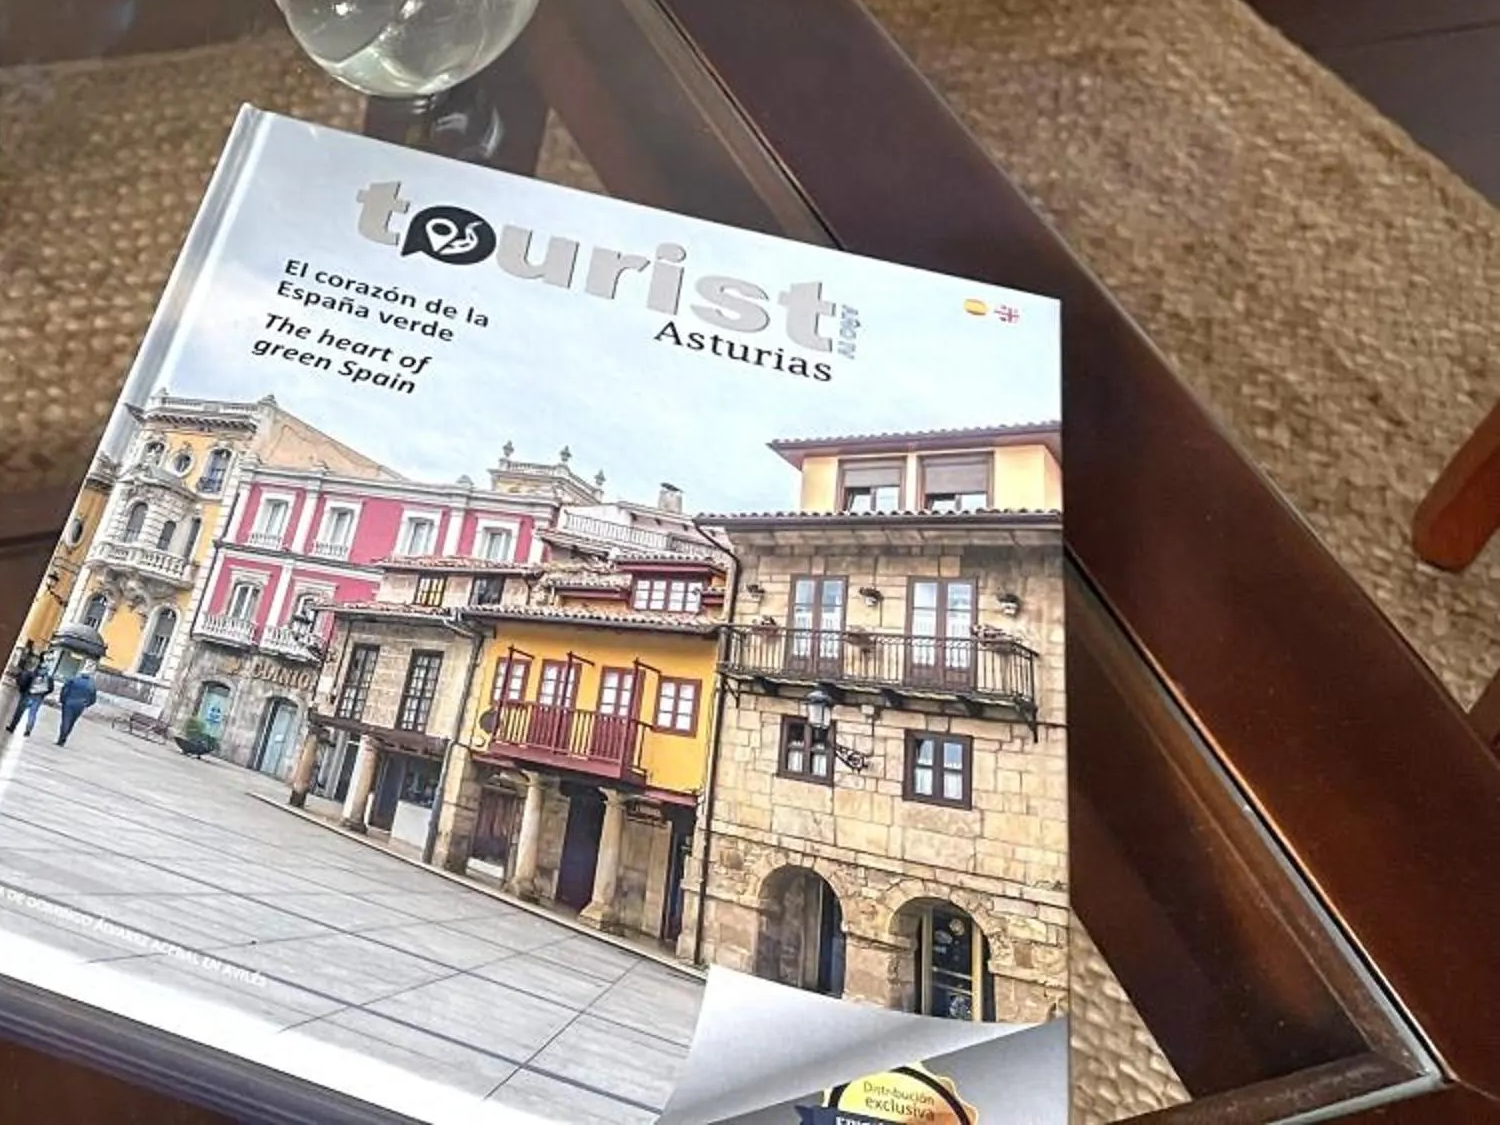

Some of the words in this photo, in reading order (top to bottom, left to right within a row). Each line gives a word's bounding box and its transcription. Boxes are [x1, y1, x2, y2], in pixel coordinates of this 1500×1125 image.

[277, 280, 370, 319] España
[379, 310, 455, 342] verde
[284, 258, 309, 278] El
[315, 269, 417, 308] corazón
[425, 298, 458, 320] de
[466, 307, 490, 328] la
[251, 339, 332, 370] green
[337, 360, 416, 394] Spain
[265, 312, 312, 340] The
[317, 328, 395, 363] heart
[399, 355, 433, 375] of
[653, 320, 834, 383] Asturias
[865, 1096, 935, 1122] exclusiva
